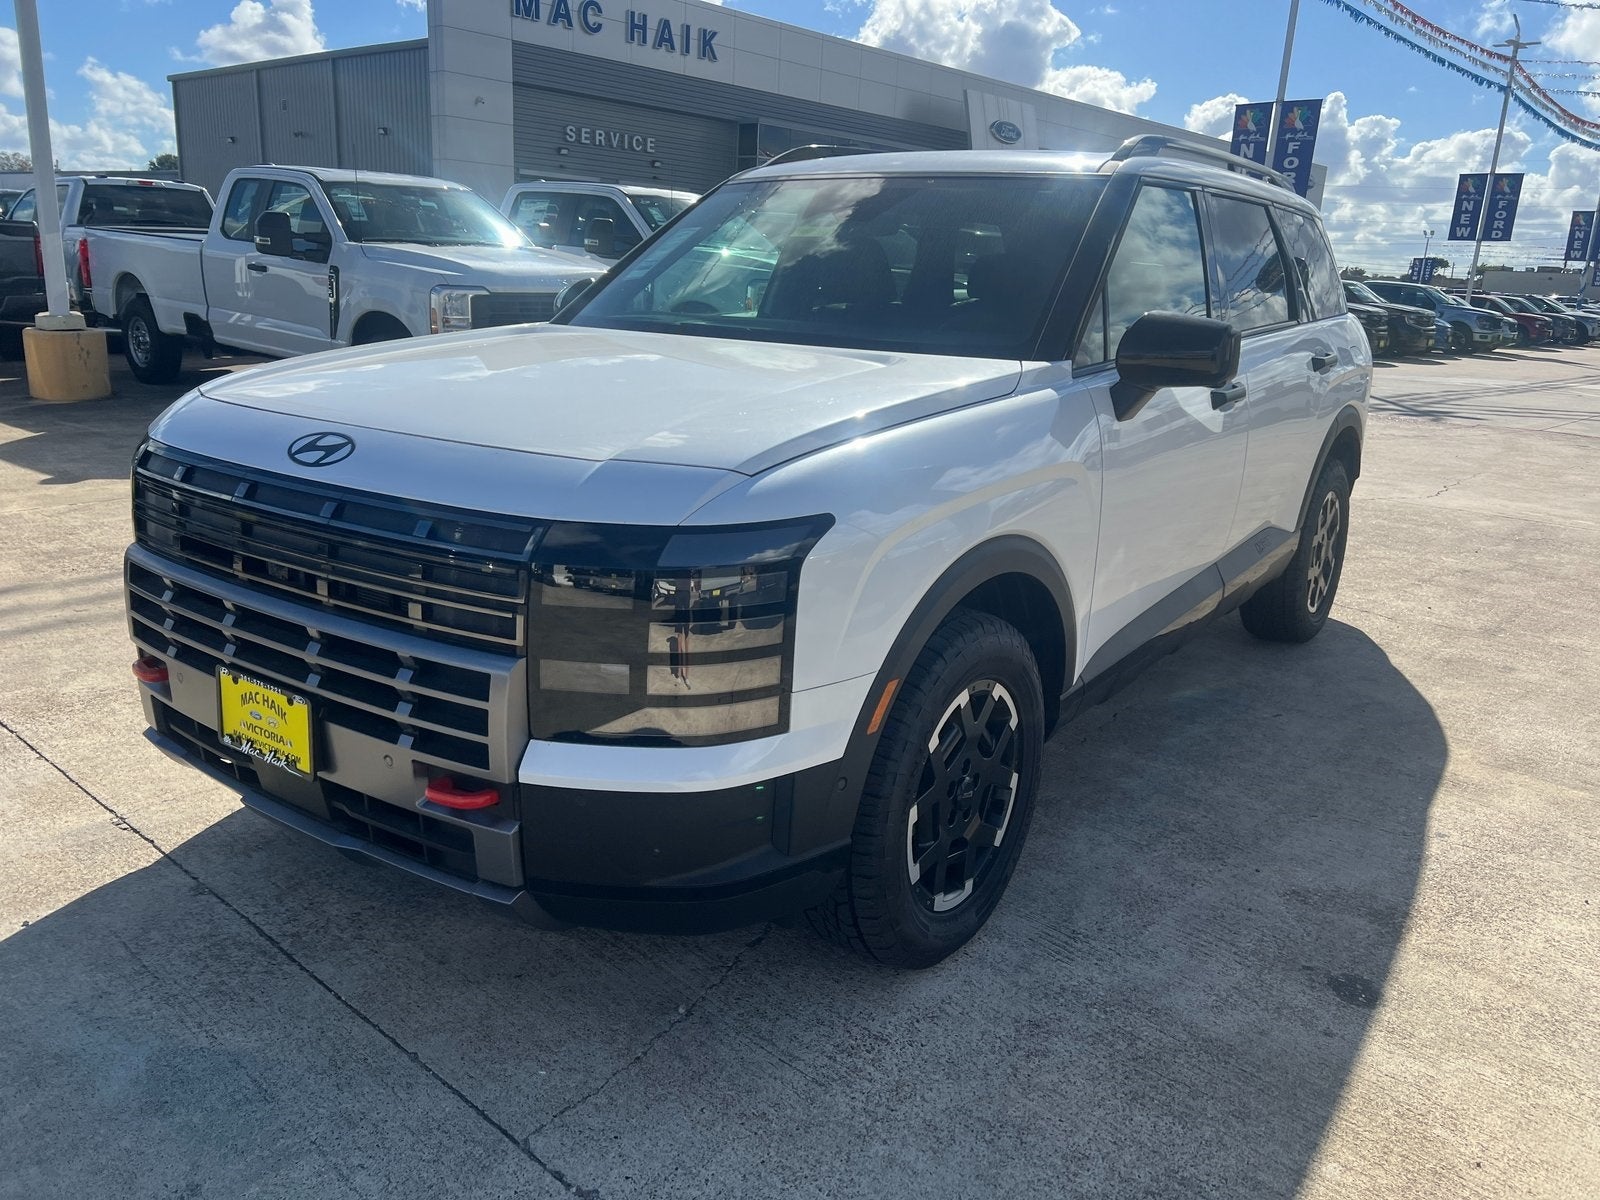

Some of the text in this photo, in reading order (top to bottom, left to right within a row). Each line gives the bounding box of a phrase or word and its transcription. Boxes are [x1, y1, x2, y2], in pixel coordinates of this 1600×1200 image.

[513, 0, 719, 61] MAC HAIK
[566, 125, 656, 153] SERVICE
[1281, 142, 1301, 185] FOR
[1456, 200, 1474, 238] NEW
[1491, 200, 1508, 239] FORD
[1570, 230, 1584, 259] NEW
[240, 691, 260, 707] MAC
[262, 694, 288, 725] HAIK
[245, 720, 286, 746] VICTORIA
[240, 740, 294, 771] Mac Haik
